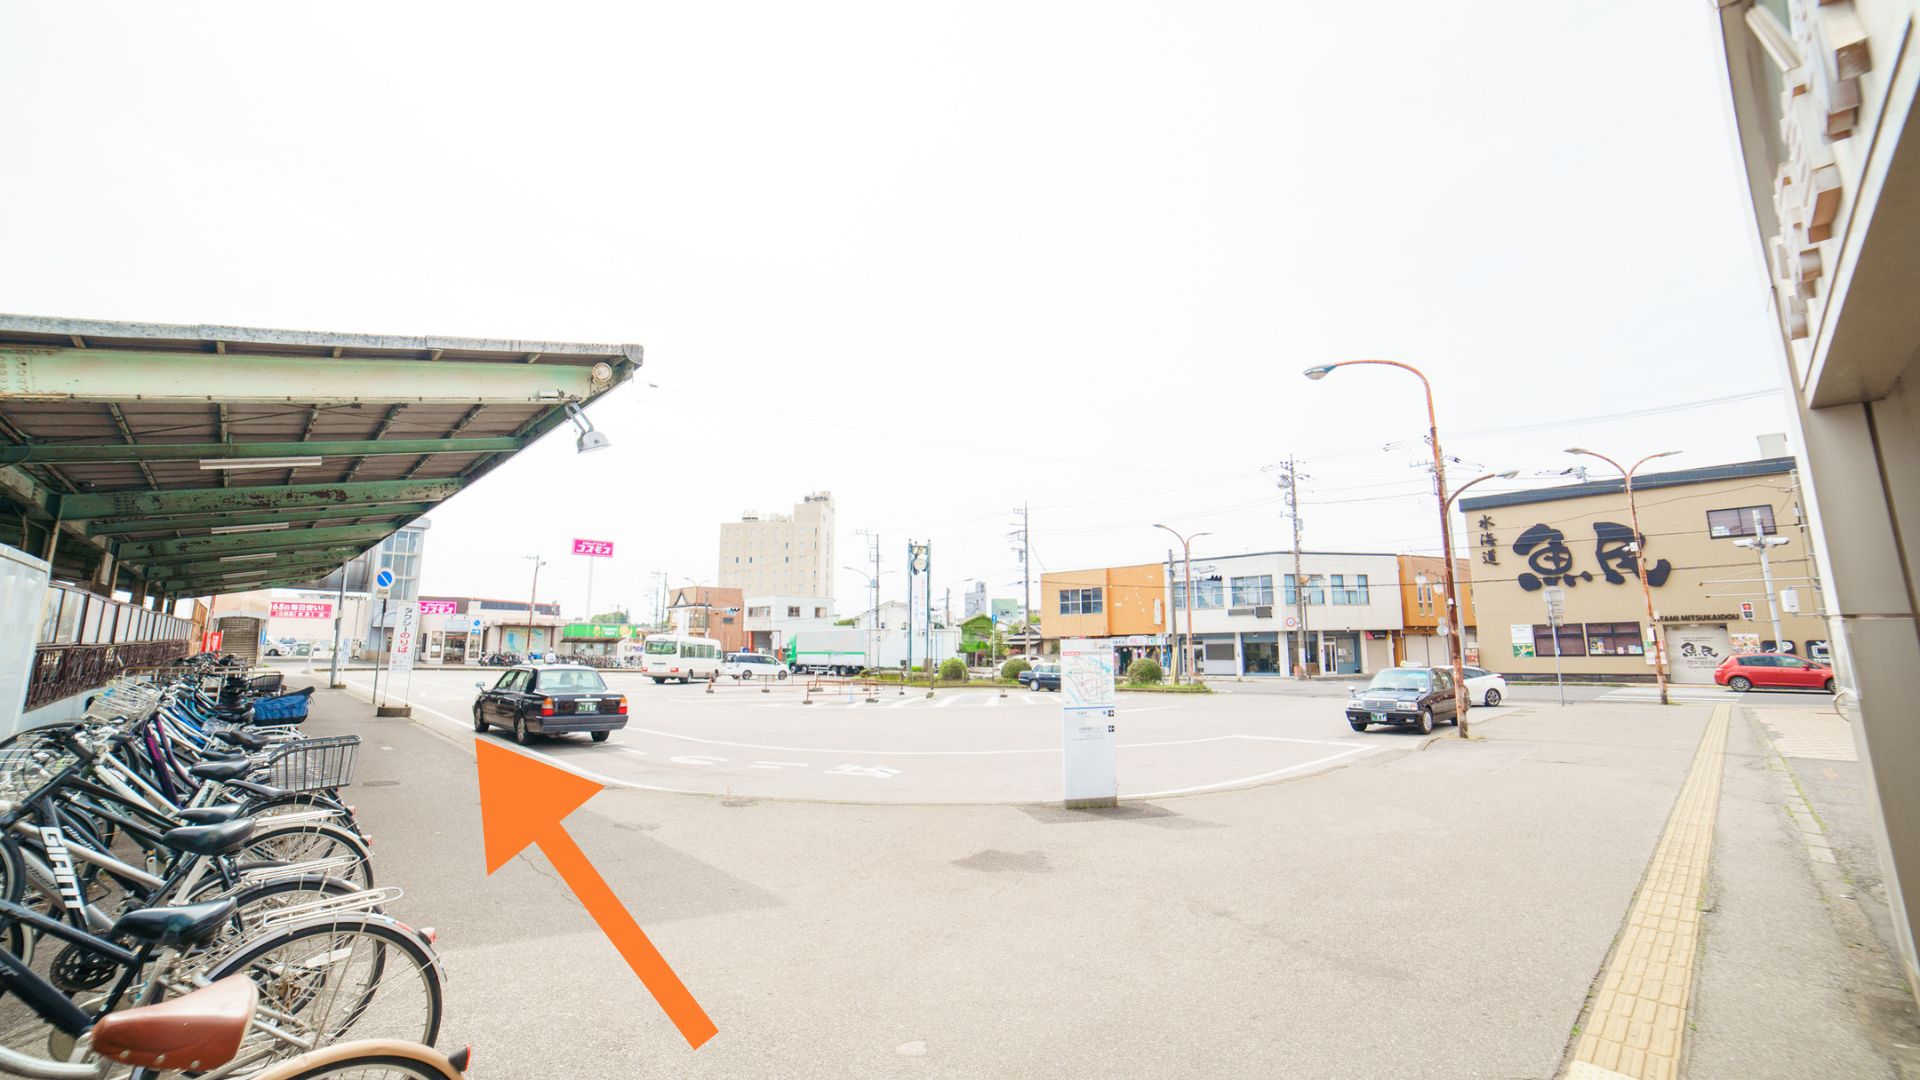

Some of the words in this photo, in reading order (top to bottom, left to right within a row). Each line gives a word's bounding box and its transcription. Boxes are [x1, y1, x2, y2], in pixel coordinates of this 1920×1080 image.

[576, 543, 612, 555] コスモス
[1478, 513, 1500, 566] 水海道
[1512, 523, 1672, 591] 魚民
[397, 607, 413, 653] タクシーのりば
[420, 605, 455, 615] コスモス
[1653, 615, 1679, 623] TAMI
[1680, 613, 1740, 622] MITSUKAIDOU
[39, 826, 86, 918] GIANT
